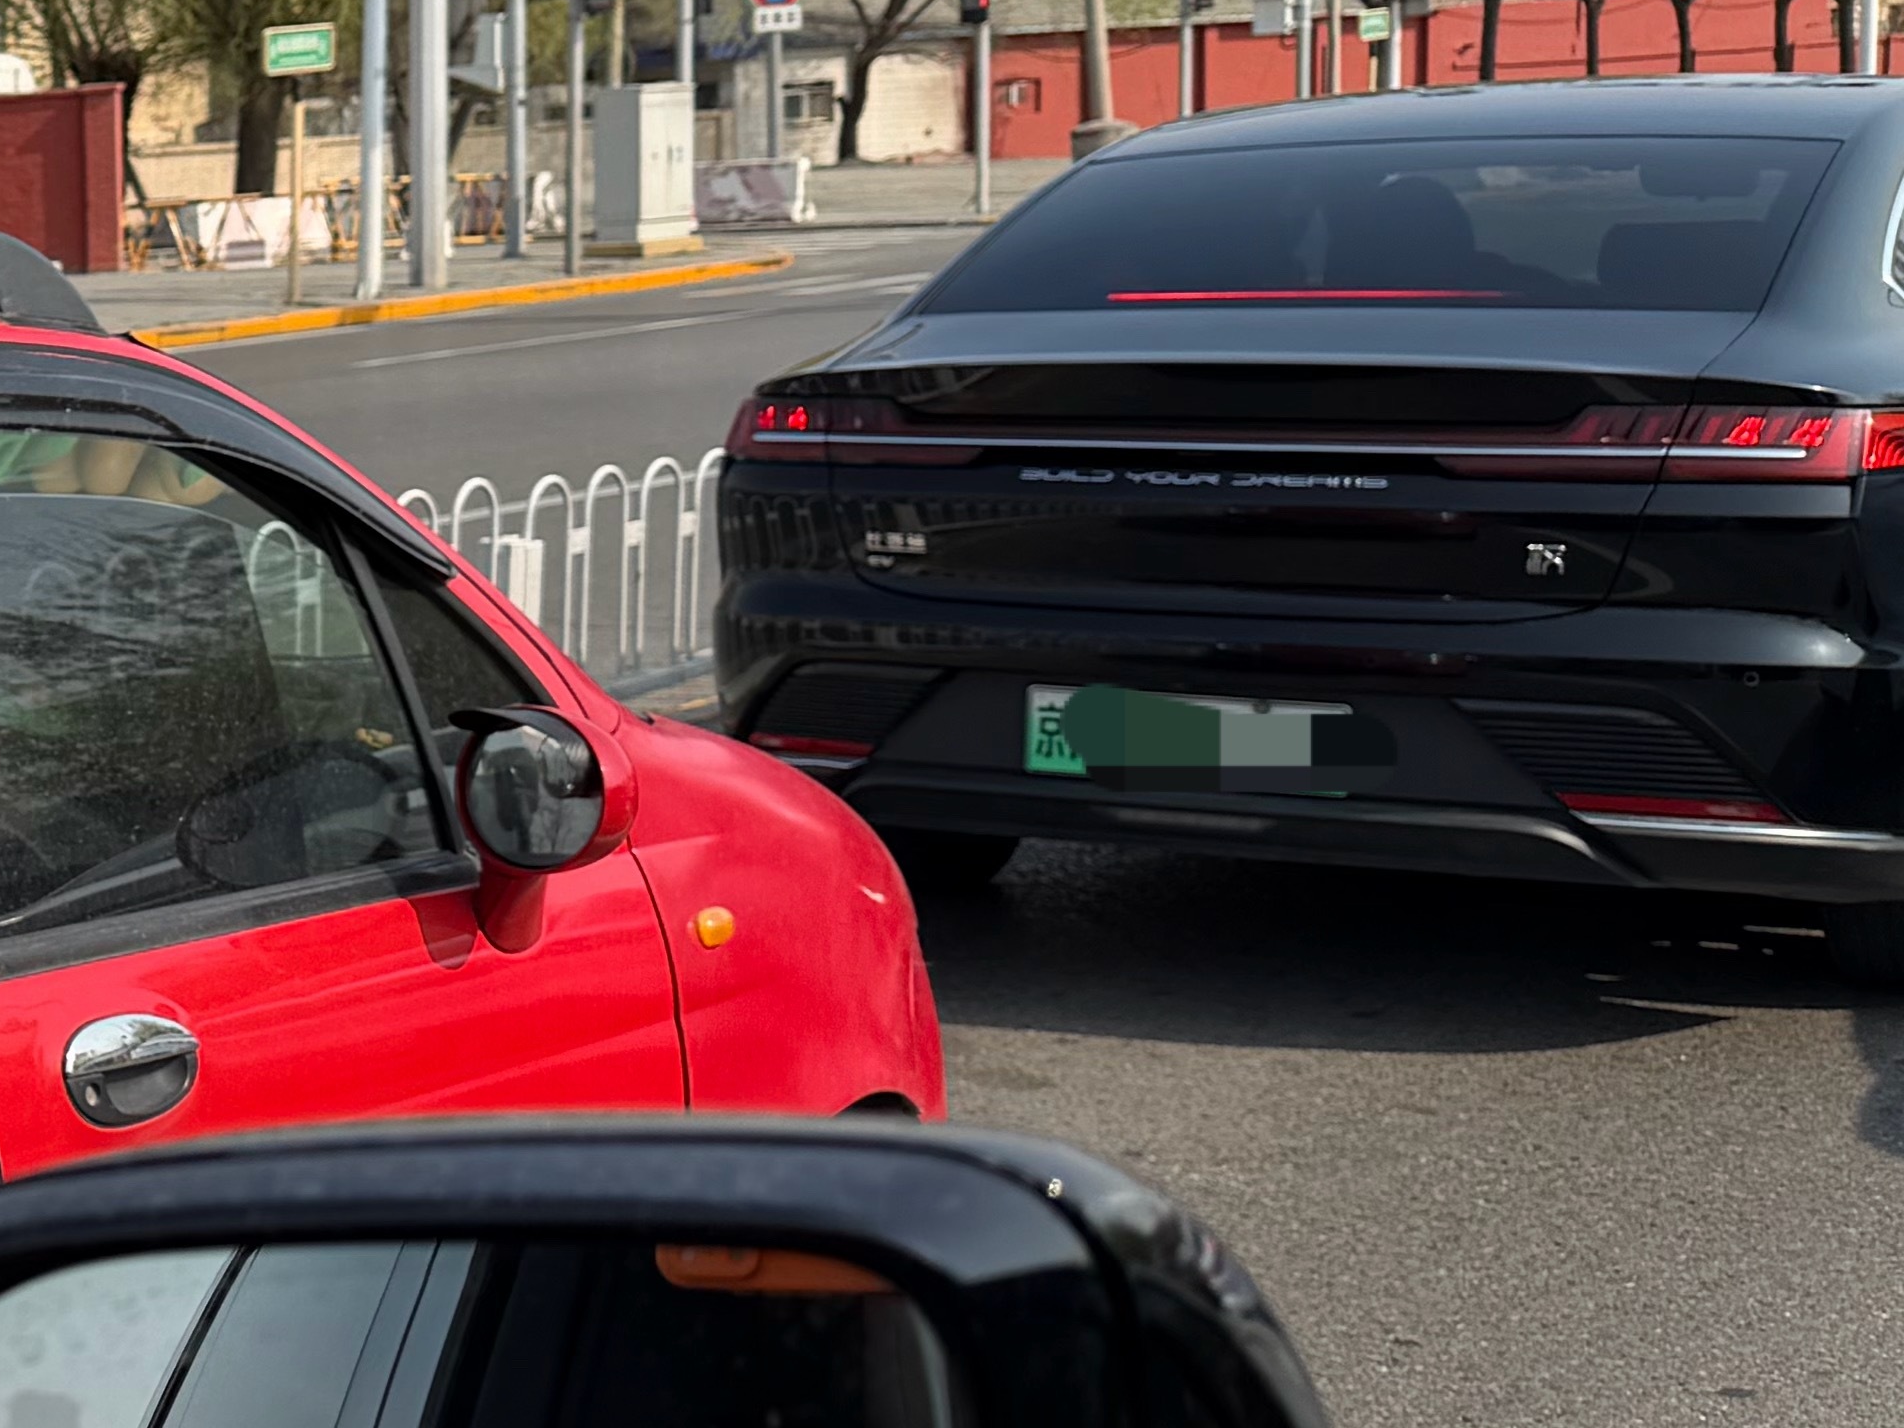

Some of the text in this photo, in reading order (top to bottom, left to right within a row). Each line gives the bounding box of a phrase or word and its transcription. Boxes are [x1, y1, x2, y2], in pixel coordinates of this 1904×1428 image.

[1019, 467, 1388, 489] BUILD YOUR DREAMS
